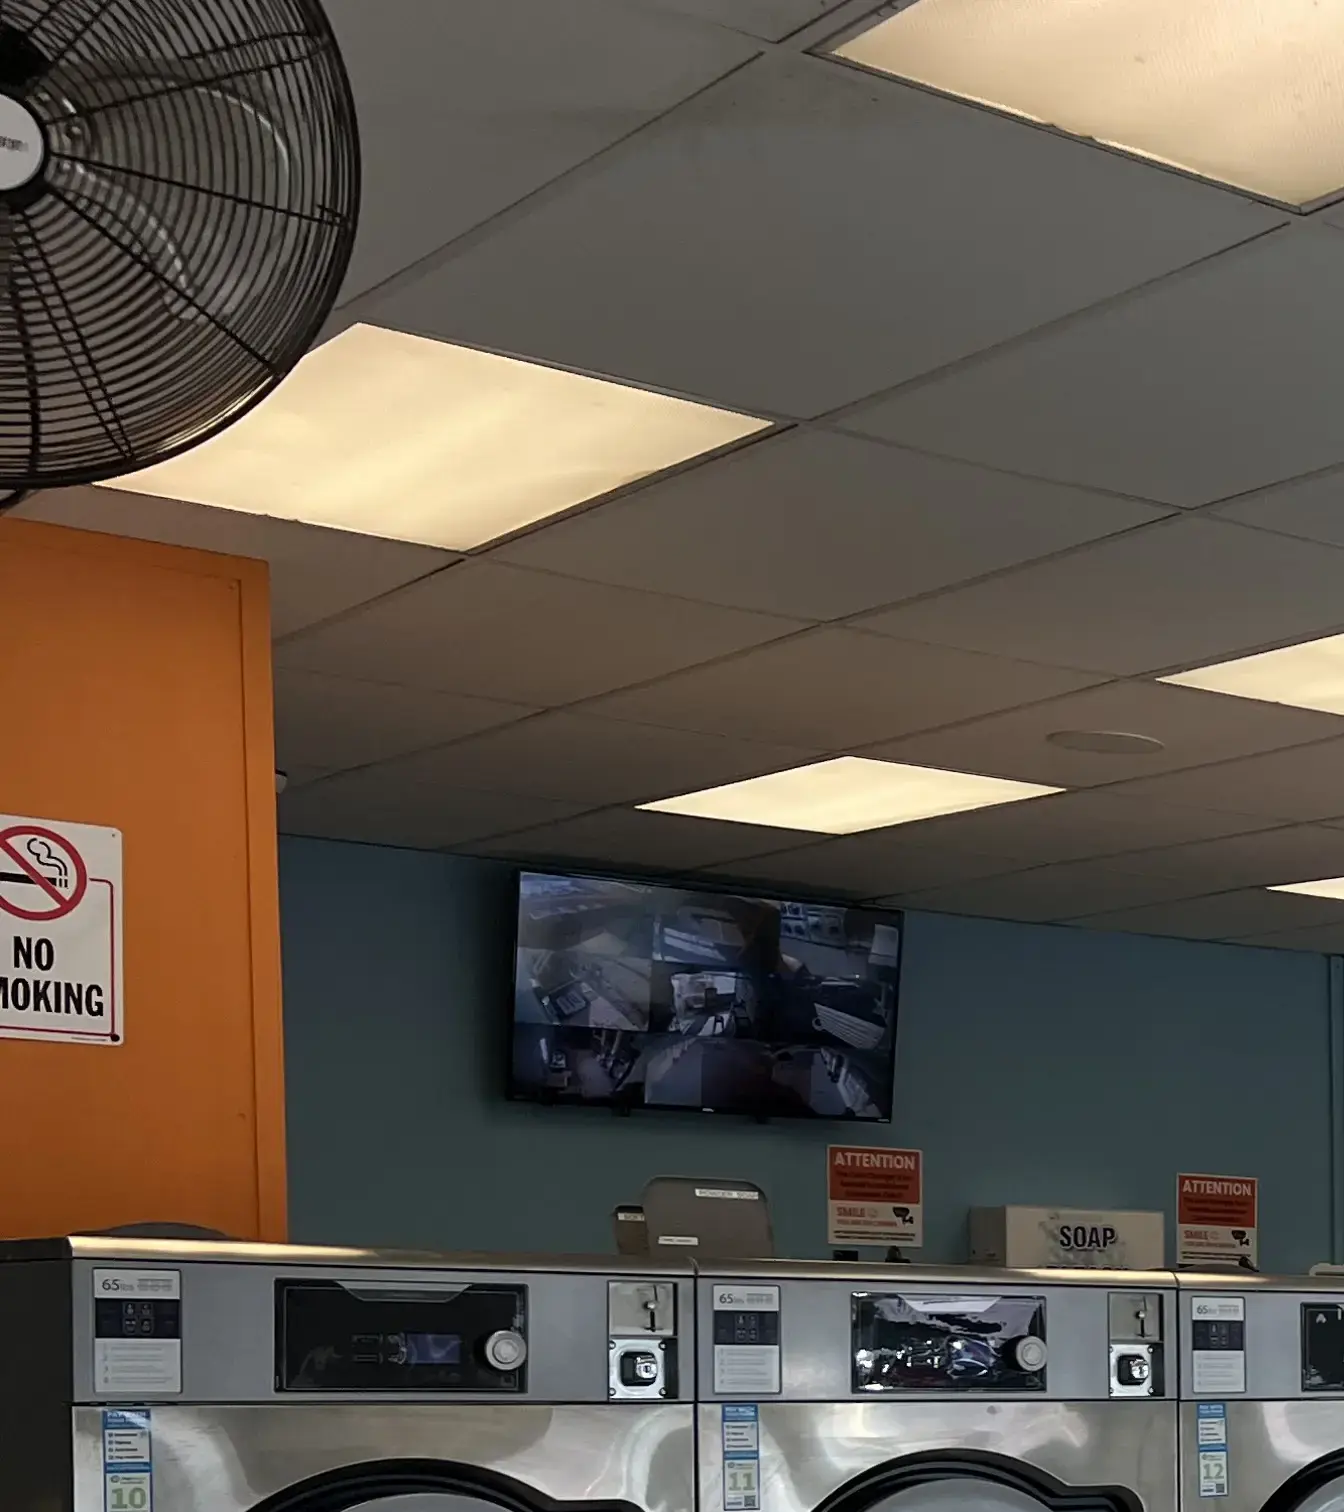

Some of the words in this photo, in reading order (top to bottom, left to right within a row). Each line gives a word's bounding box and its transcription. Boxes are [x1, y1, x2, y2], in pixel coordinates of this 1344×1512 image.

[13, 935, 55, 971] NO
[834, 1152, 916, 1170] ATTENTION
[1182, 1179, 1252, 1196] ATTENTION
[1059, 1225, 1116, 1249] SOAP
[1203, 1463, 1225, 1480] 12
[728, 1473, 755, 1491] 11
[111, 1487, 146, 1510] 10
